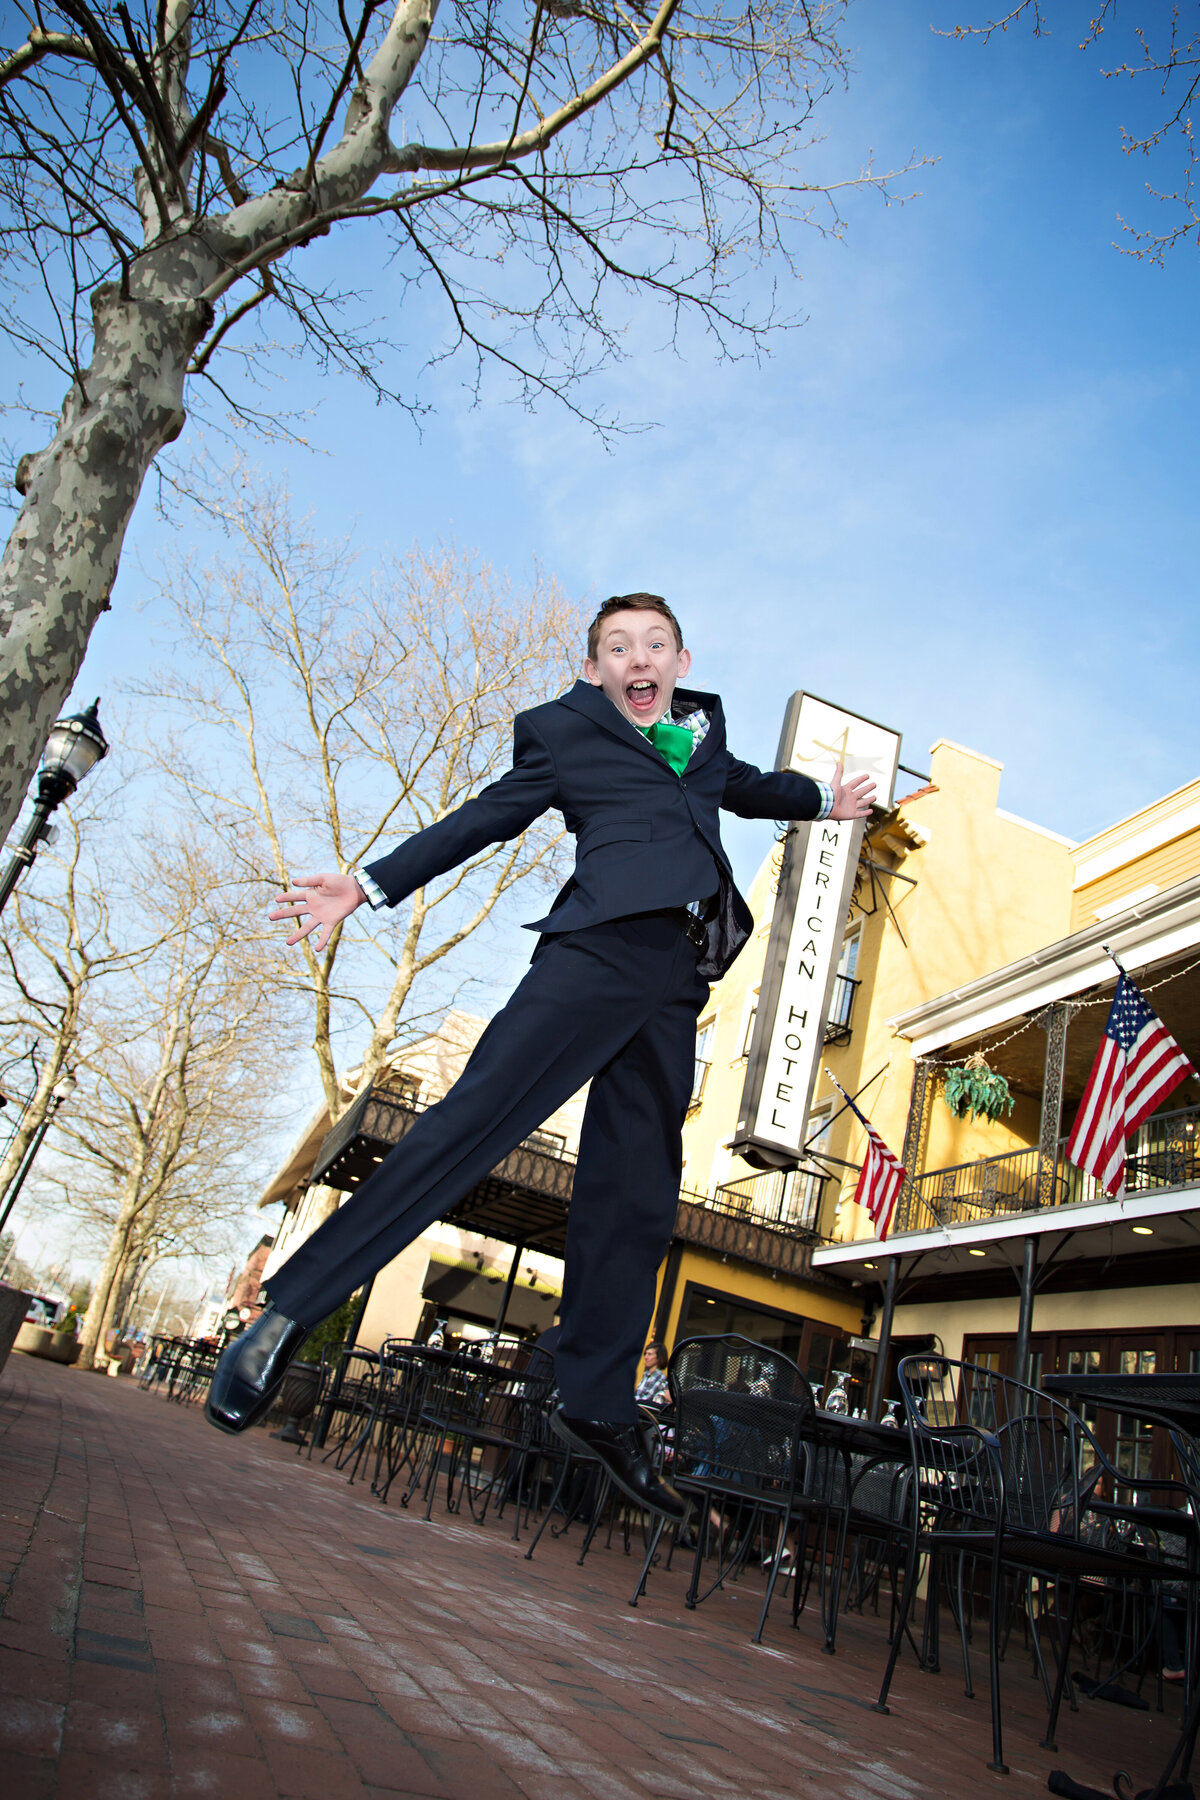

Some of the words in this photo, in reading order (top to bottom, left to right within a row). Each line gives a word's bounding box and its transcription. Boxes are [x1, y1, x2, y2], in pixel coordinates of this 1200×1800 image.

[796, 726, 856, 776] A
[798, 819, 841, 980] MERICAN
[771, 1005, 808, 1129] HOTEL
